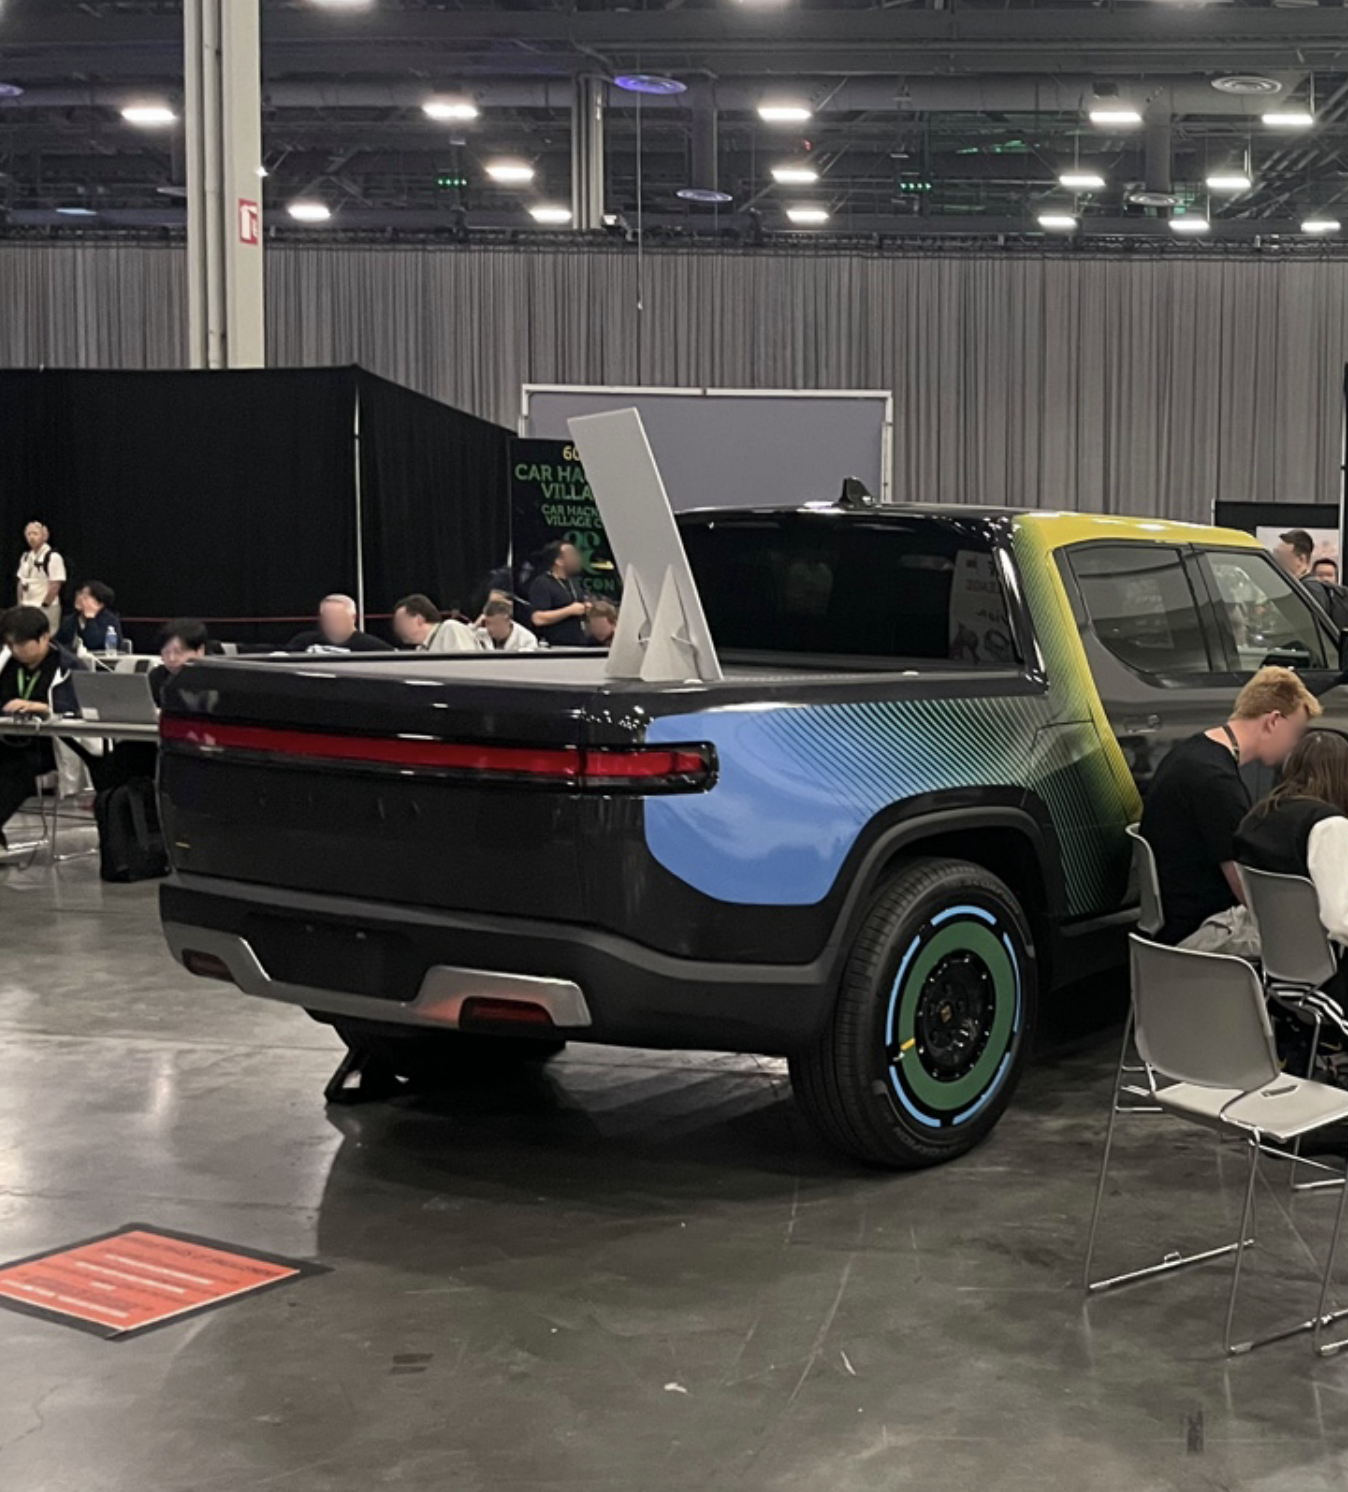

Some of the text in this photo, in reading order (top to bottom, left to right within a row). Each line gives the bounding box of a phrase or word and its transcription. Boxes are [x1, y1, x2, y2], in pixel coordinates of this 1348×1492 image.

[563, 445, 580, 461] 60
[515, 464, 586, 483] CAR HA
[541, 483, 595, 501] VILLA
[541, 503, 564, 515] CAR
[546, 516, 592, 528] VILLAGE
